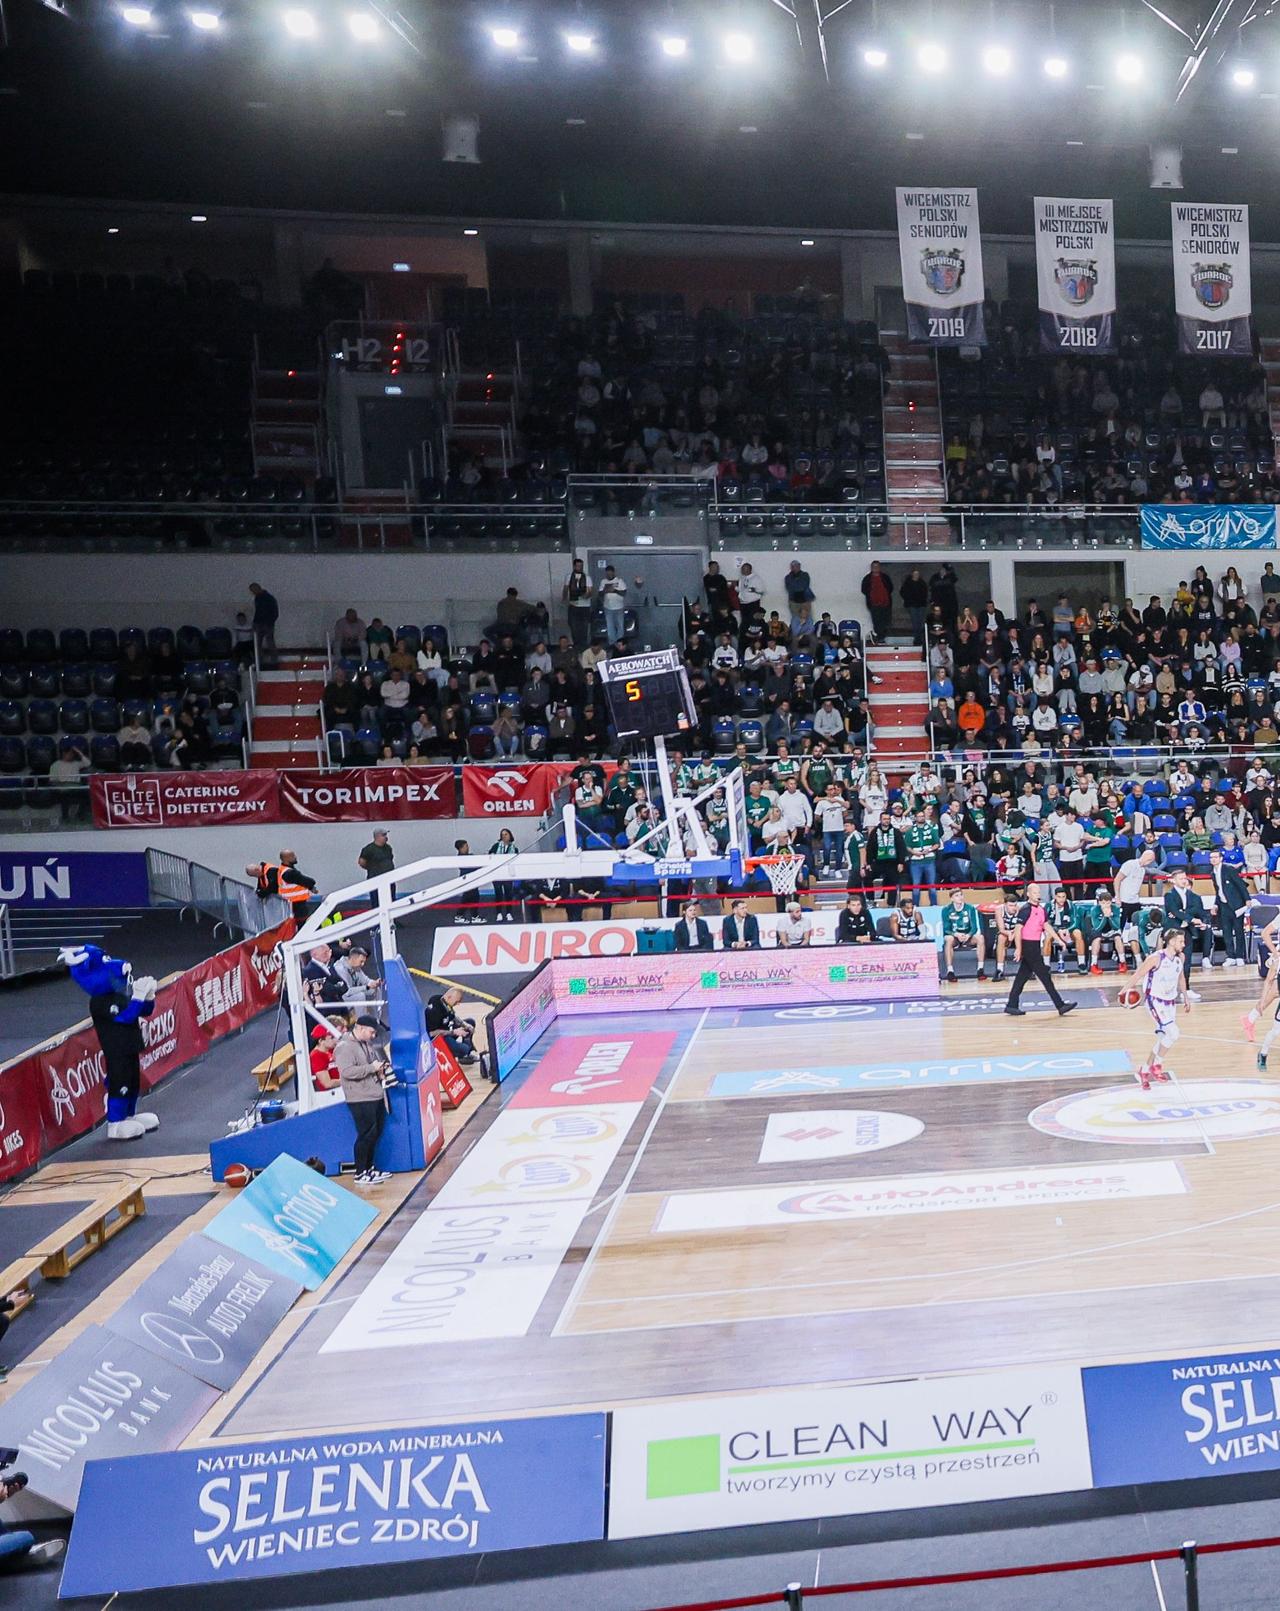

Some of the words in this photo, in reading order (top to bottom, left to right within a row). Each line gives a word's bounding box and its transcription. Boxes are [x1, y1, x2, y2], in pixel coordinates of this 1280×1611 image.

[904, 193, 971, 207] WICEMISTRZ
[919, 209, 958, 222] POLSKI
[1045, 205, 1054, 217] III
[1058, 206, 1102, 219] MIEJSCE
[1177, 207, 1243, 222] WICEMISTRZ
[910, 223, 968, 238] SENIORÓW
[1040, 220, 1109, 234] MISTRZOSTW
[1191, 223, 1230, 238] POLSKI
[1056, 236, 1094, 249] POLSKI
[1181, 238, 1239, 255] SENIORÓW
[928, 318, 965, 337] 2019
[1060, 327, 1097, 347] 2018
[1196, 330, 1232, 350] 2017
[607, 655, 671, 674] AEROWATCH
[625, 680, 641, 701] 5
[164, 785, 240, 798] CATERING
[298, 784, 441, 805] TORIMPEX
[113, 802, 156, 816] DIET
[166, 800, 266, 814] DIETETYCZNY
[483, 799, 534, 812] ORLEN
[438, 925, 635, 968] ANIRO
[719, 970, 758, 981] CLEAN
[766, 968, 793, 978] WAY
[847, 963, 885, 974] CLEAN
[892, 961, 918, 972] WAY
[588, 977, 627, 987] CLEAN
[637, 974, 664, 985] WAY
[859, 1055, 1096, 1080] arriva
[1127, 1101, 1257, 1122] LOTTO
[820, 1174, 1126, 1204] AutoAndreas
[501, 1209, 557, 1262] BANK
[368, 1213, 509, 1335] NICOLAUS
[168, 1254, 235, 1317] Mercedes-Benz
[1172, 1357, 1272, 1381] NATURALNA
[17, 1361, 143, 1471] NICOLAUS
[118, 1385, 172, 1438] BANK
[727, 1418, 889, 1463] CLEAN
[932, 1404, 1035, 1443] WAY
[196, 1448, 319, 1473] NATURALNA
[323, 1440, 386, 1459] WODA
[387, 1430, 504, 1452] MINERALNA
[726, 1470, 837, 1495] tworzymy
[843, 1460, 918, 1485] czystą
[922, 1447, 1041, 1479] przestrzeń
[193, 1453, 490, 1544] SELENKA
[206, 1520, 362, 1569] WIENIEC
[371, 1513, 480, 1549] ZDRÓJ
